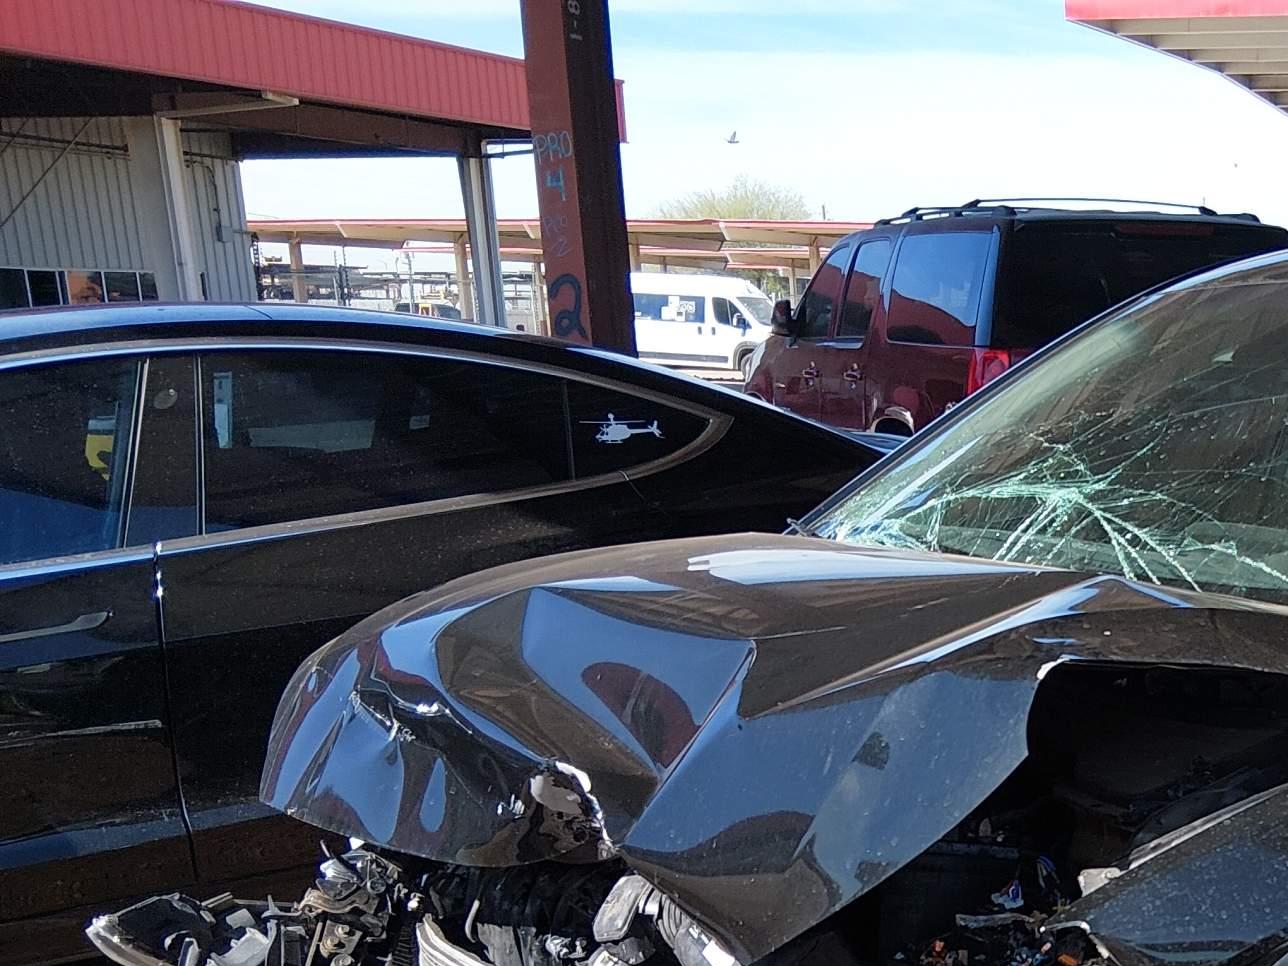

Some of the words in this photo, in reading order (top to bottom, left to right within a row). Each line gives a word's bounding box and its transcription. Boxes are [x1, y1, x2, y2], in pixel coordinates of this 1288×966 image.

[533, 130, 573, 164] PRO
[545, 166, 567, 201] 4
[548, 273, 588, 338] 2
